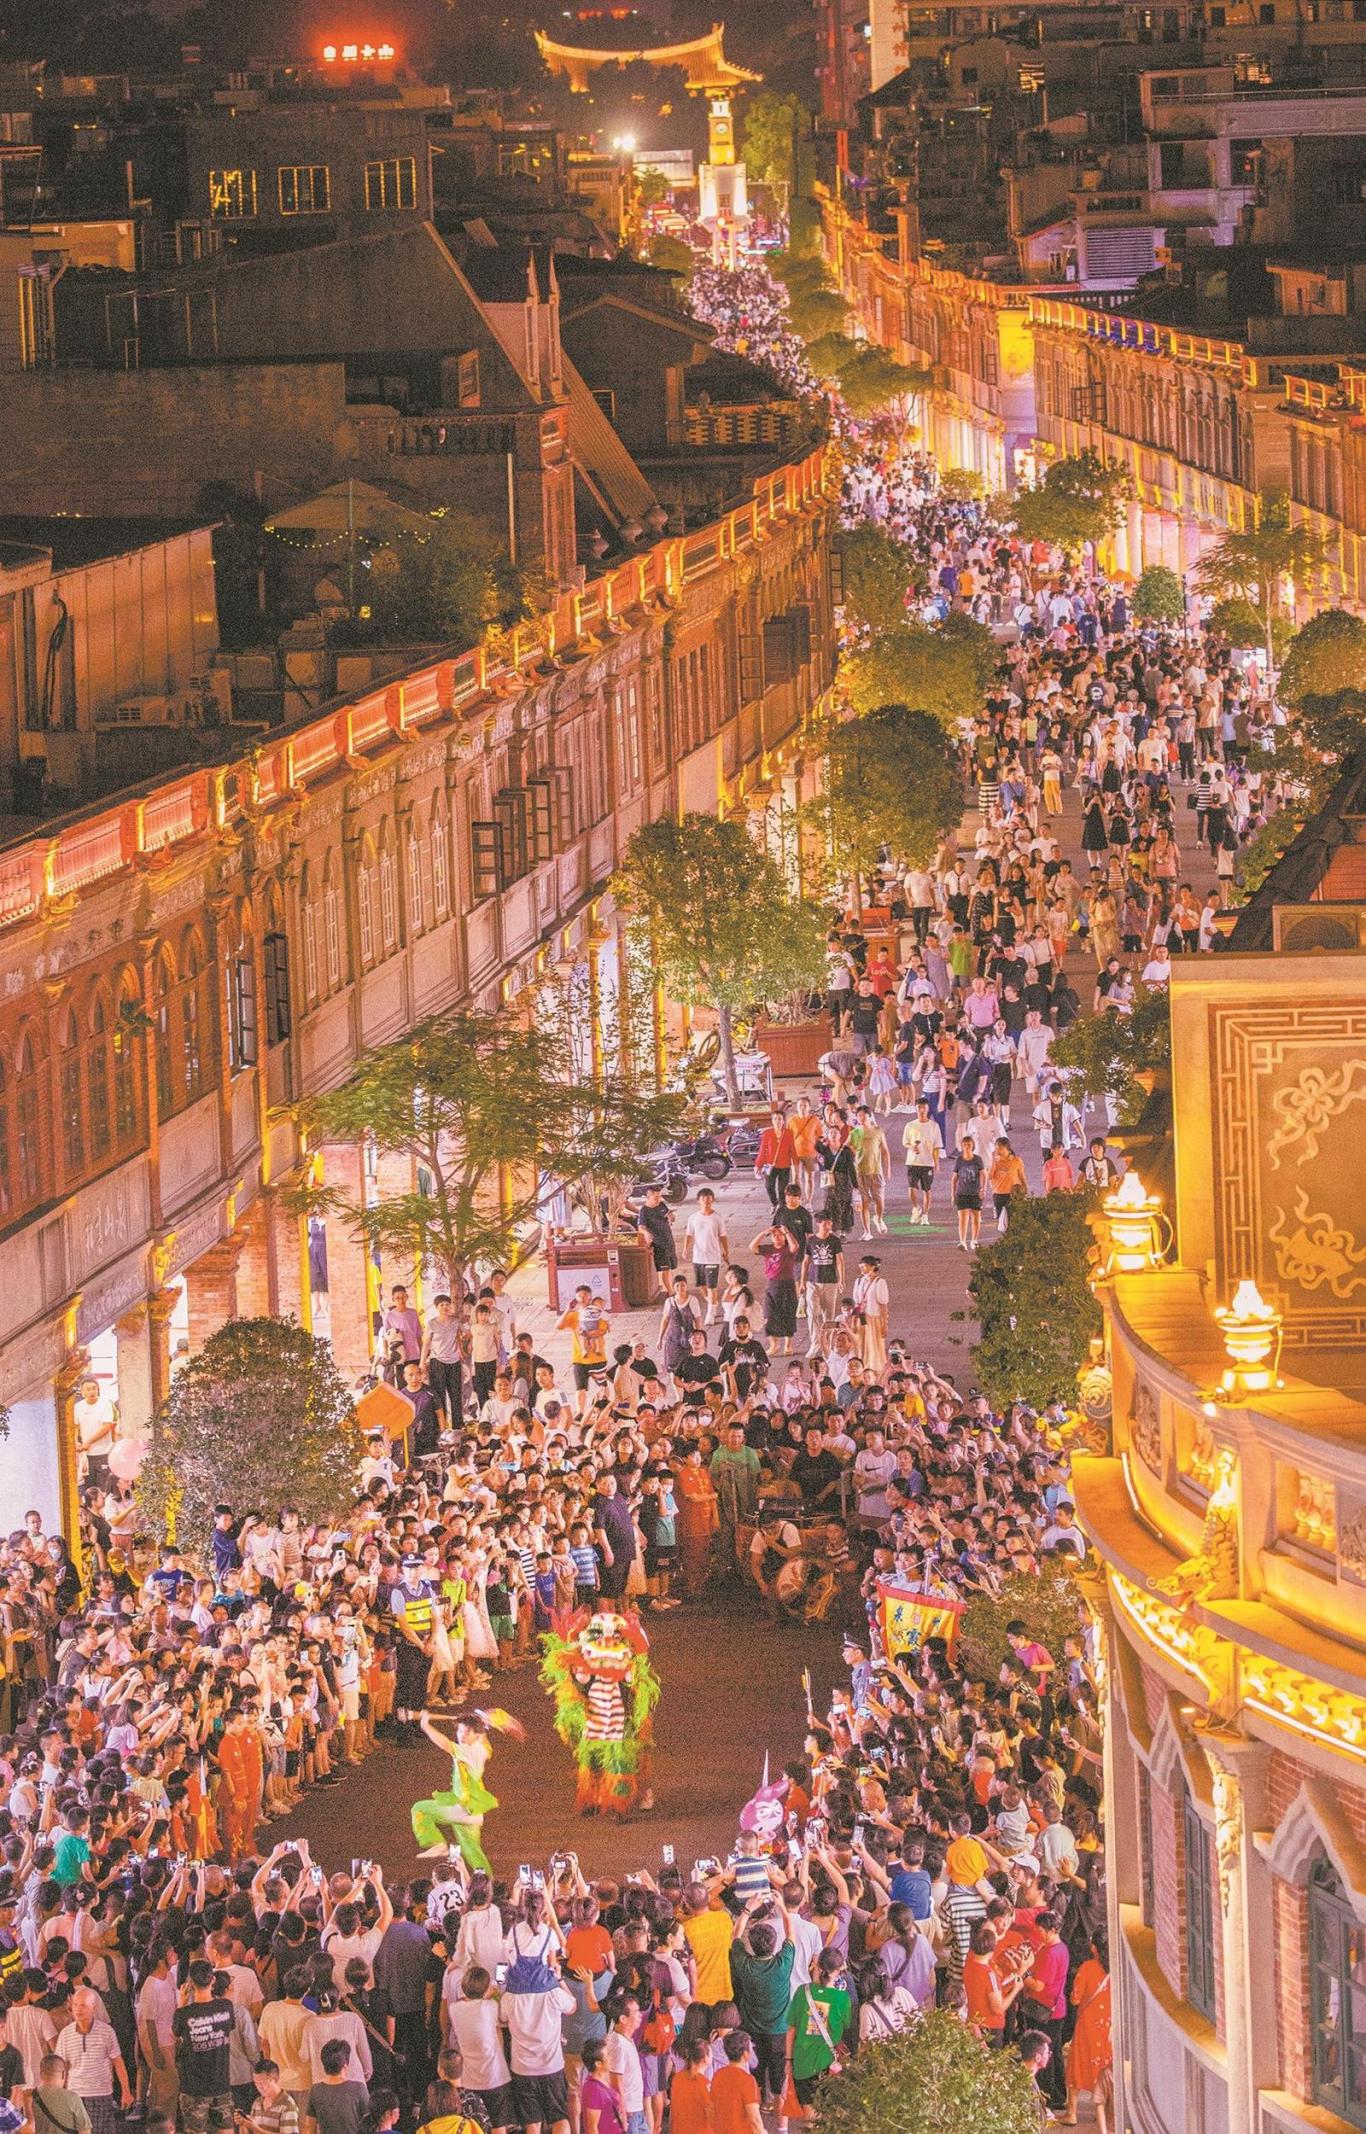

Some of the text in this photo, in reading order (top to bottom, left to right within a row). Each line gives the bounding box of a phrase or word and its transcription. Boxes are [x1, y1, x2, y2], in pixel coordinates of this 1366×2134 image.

[439, 1889, 464, 1911] 23
[187, 2016, 213, 2028] Calvin
[189, 2025, 213, 2035] Jeans
[208, 2029, 225, 2039] York
